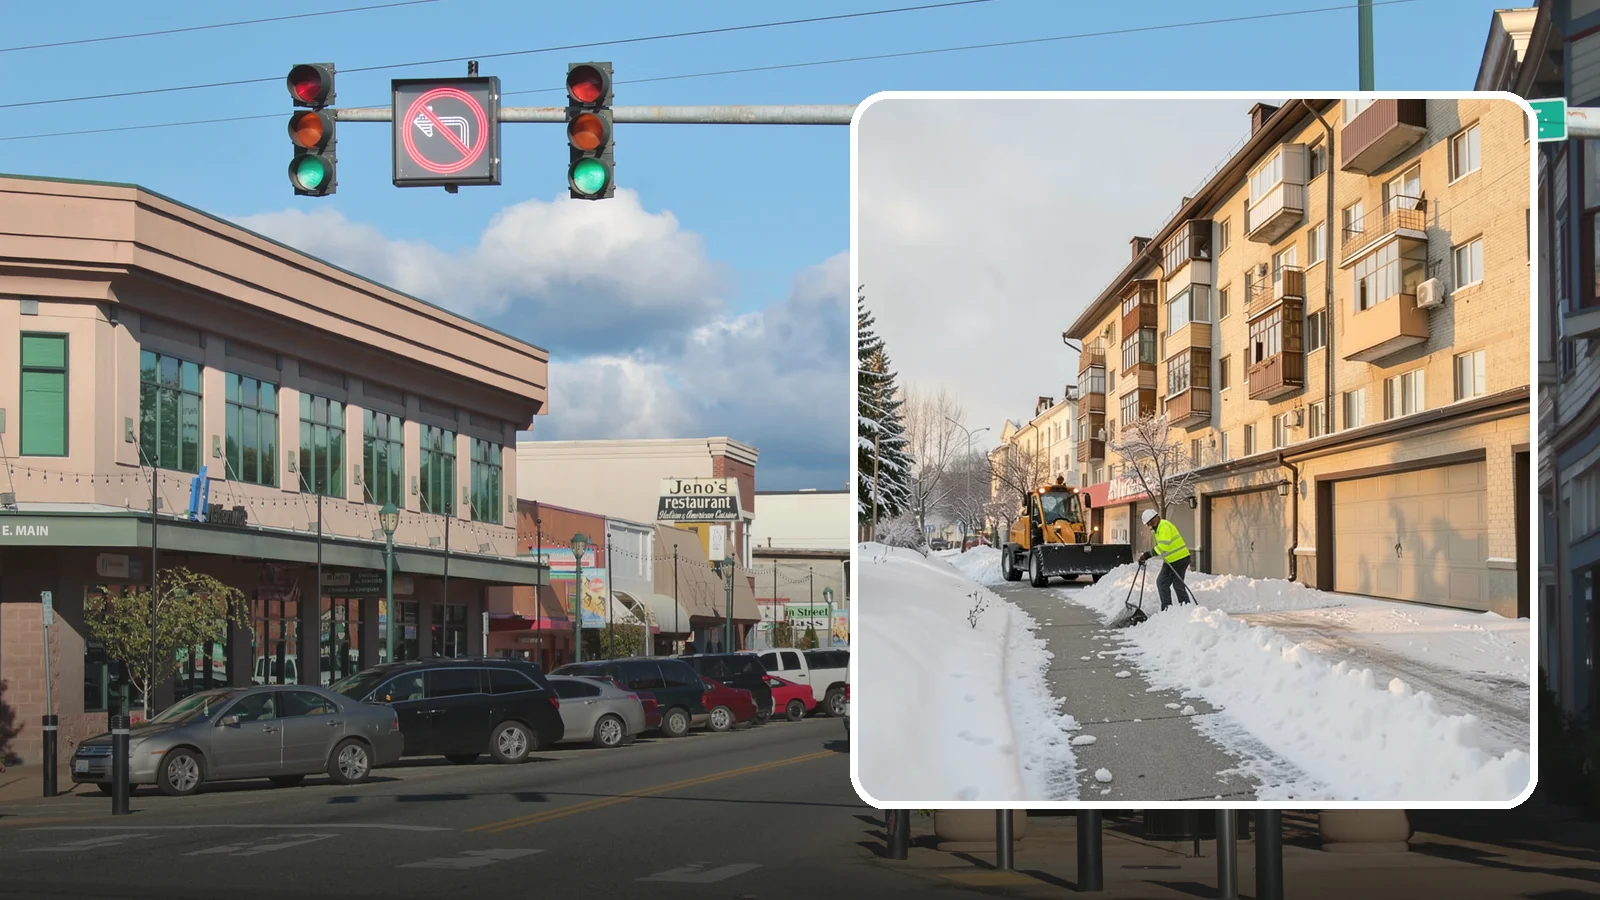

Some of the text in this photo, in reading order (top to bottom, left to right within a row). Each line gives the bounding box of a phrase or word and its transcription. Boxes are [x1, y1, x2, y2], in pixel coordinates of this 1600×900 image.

[670, 480, 728, 495] Jeno's
[665, 497, 731, 509] restaurant
[659, 510, 682, 520] Italian
[686, 510, 714, 519] American
[715, 509, 737, 519] Cuisine
[2, 525, 49, 536] E. MAIN
[797, 607, 828, 617] Street
[791, 619, 824, 627] lass
